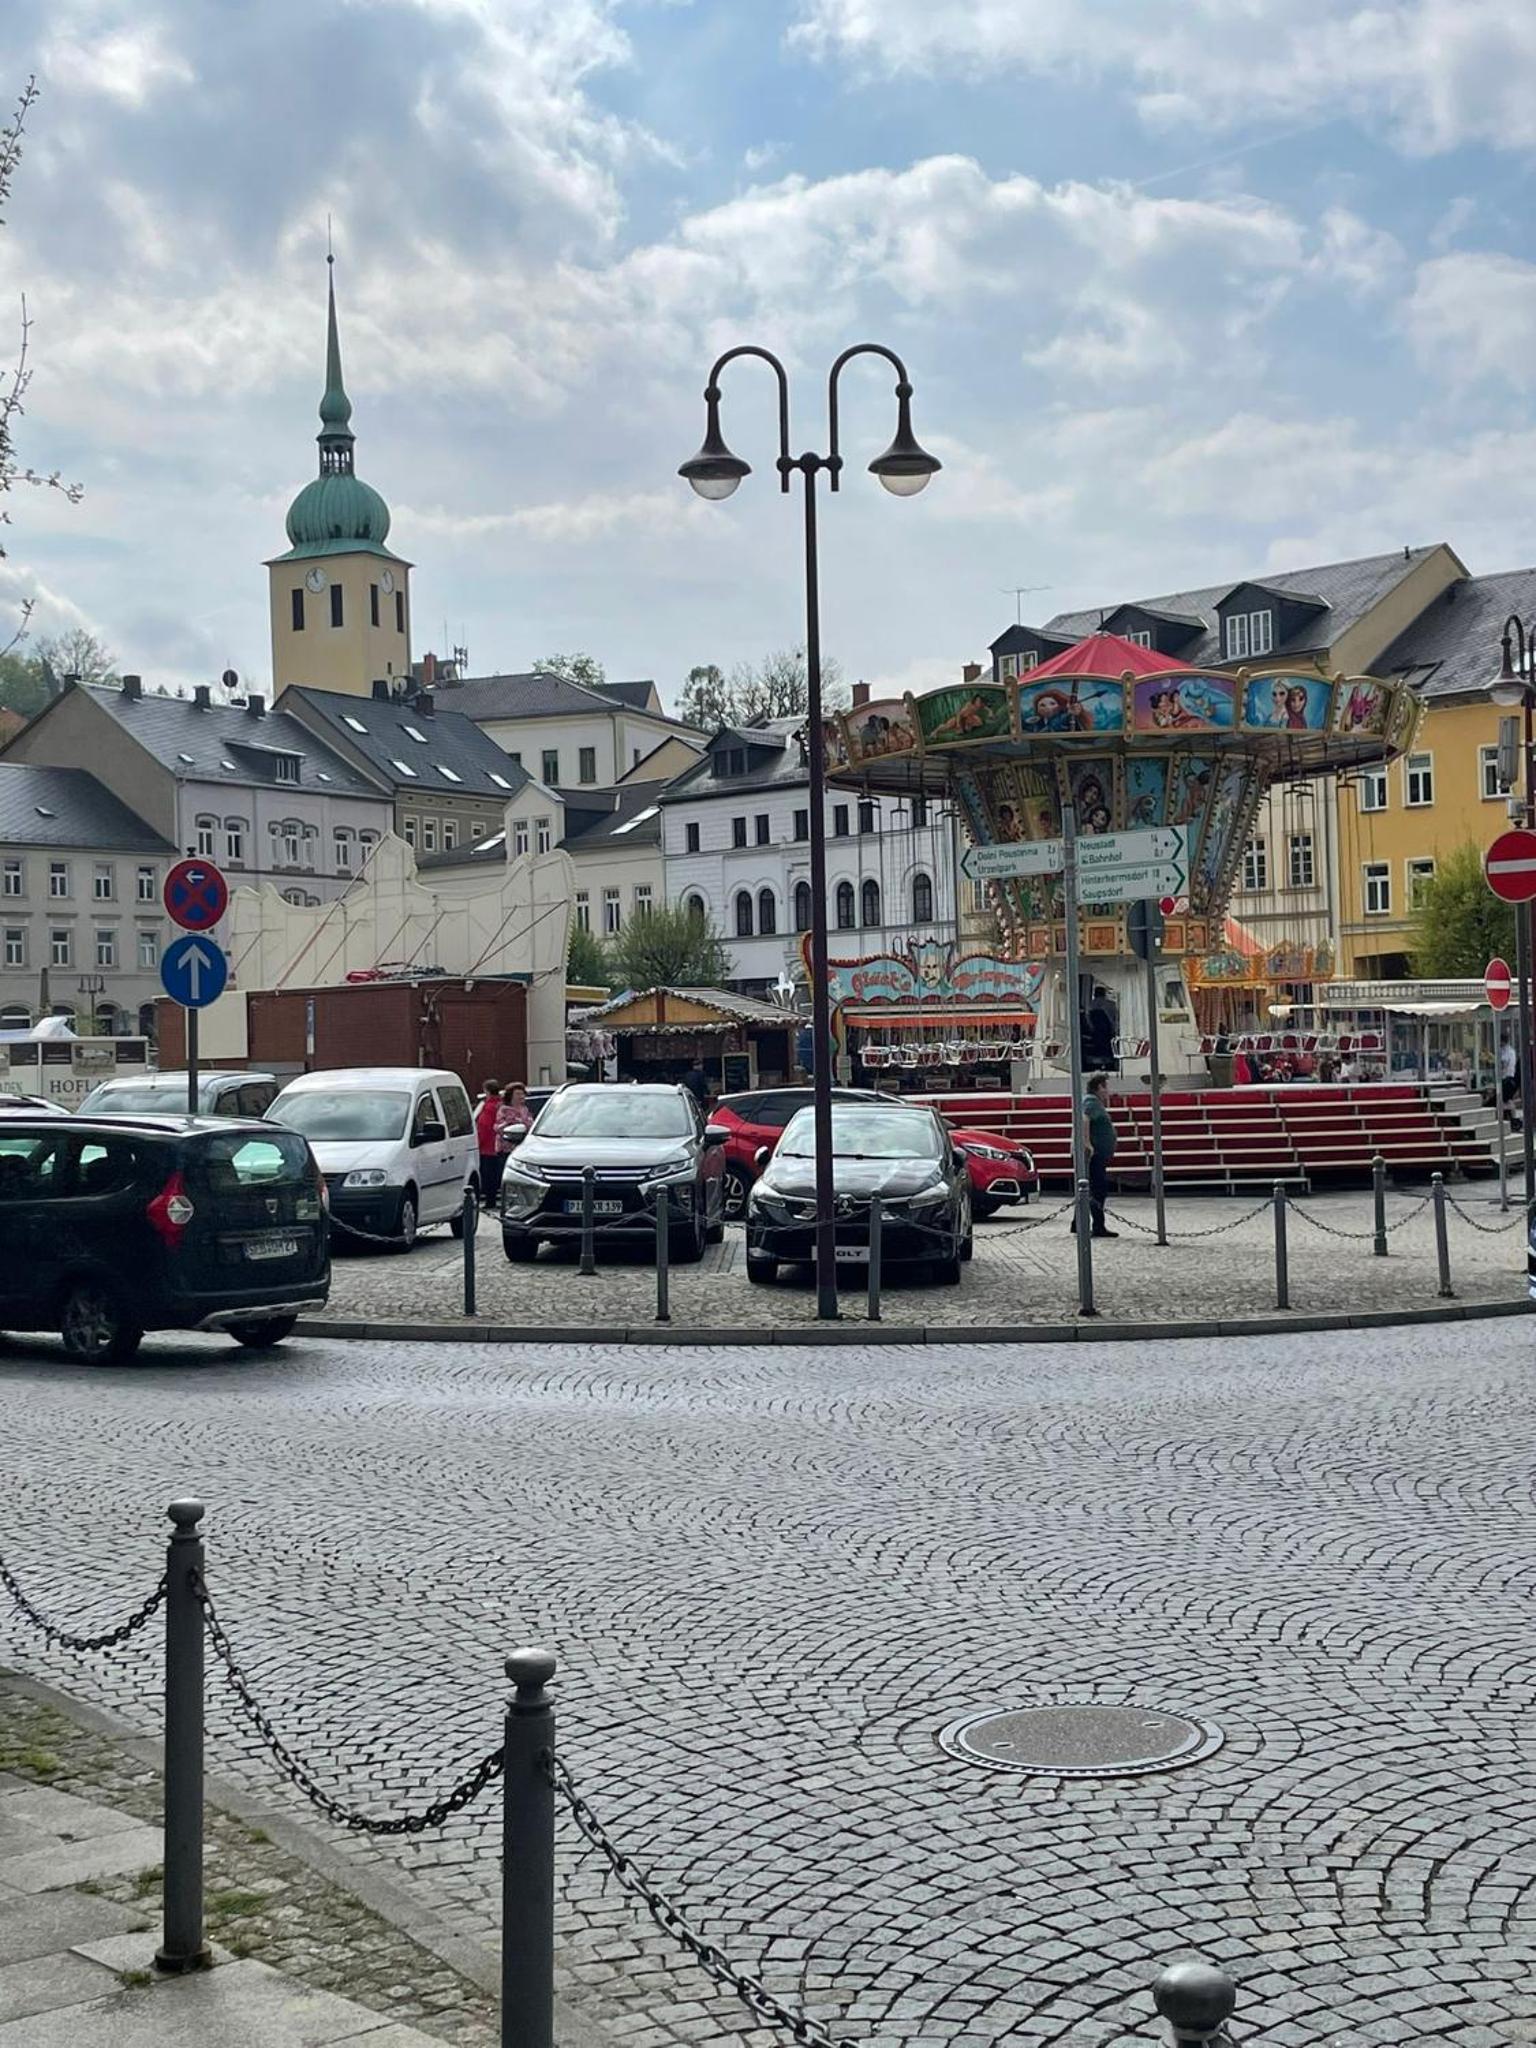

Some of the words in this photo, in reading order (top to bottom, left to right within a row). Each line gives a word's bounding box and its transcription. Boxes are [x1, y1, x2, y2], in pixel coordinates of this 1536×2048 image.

[1079, 839, 1116, 851] Neustadt
[1089, 851, 1122, 864] Bahnhof
[1081, 869, 1149, 885] Hinterhermsdorf
[836, 1250, 864, 1258] OLT
